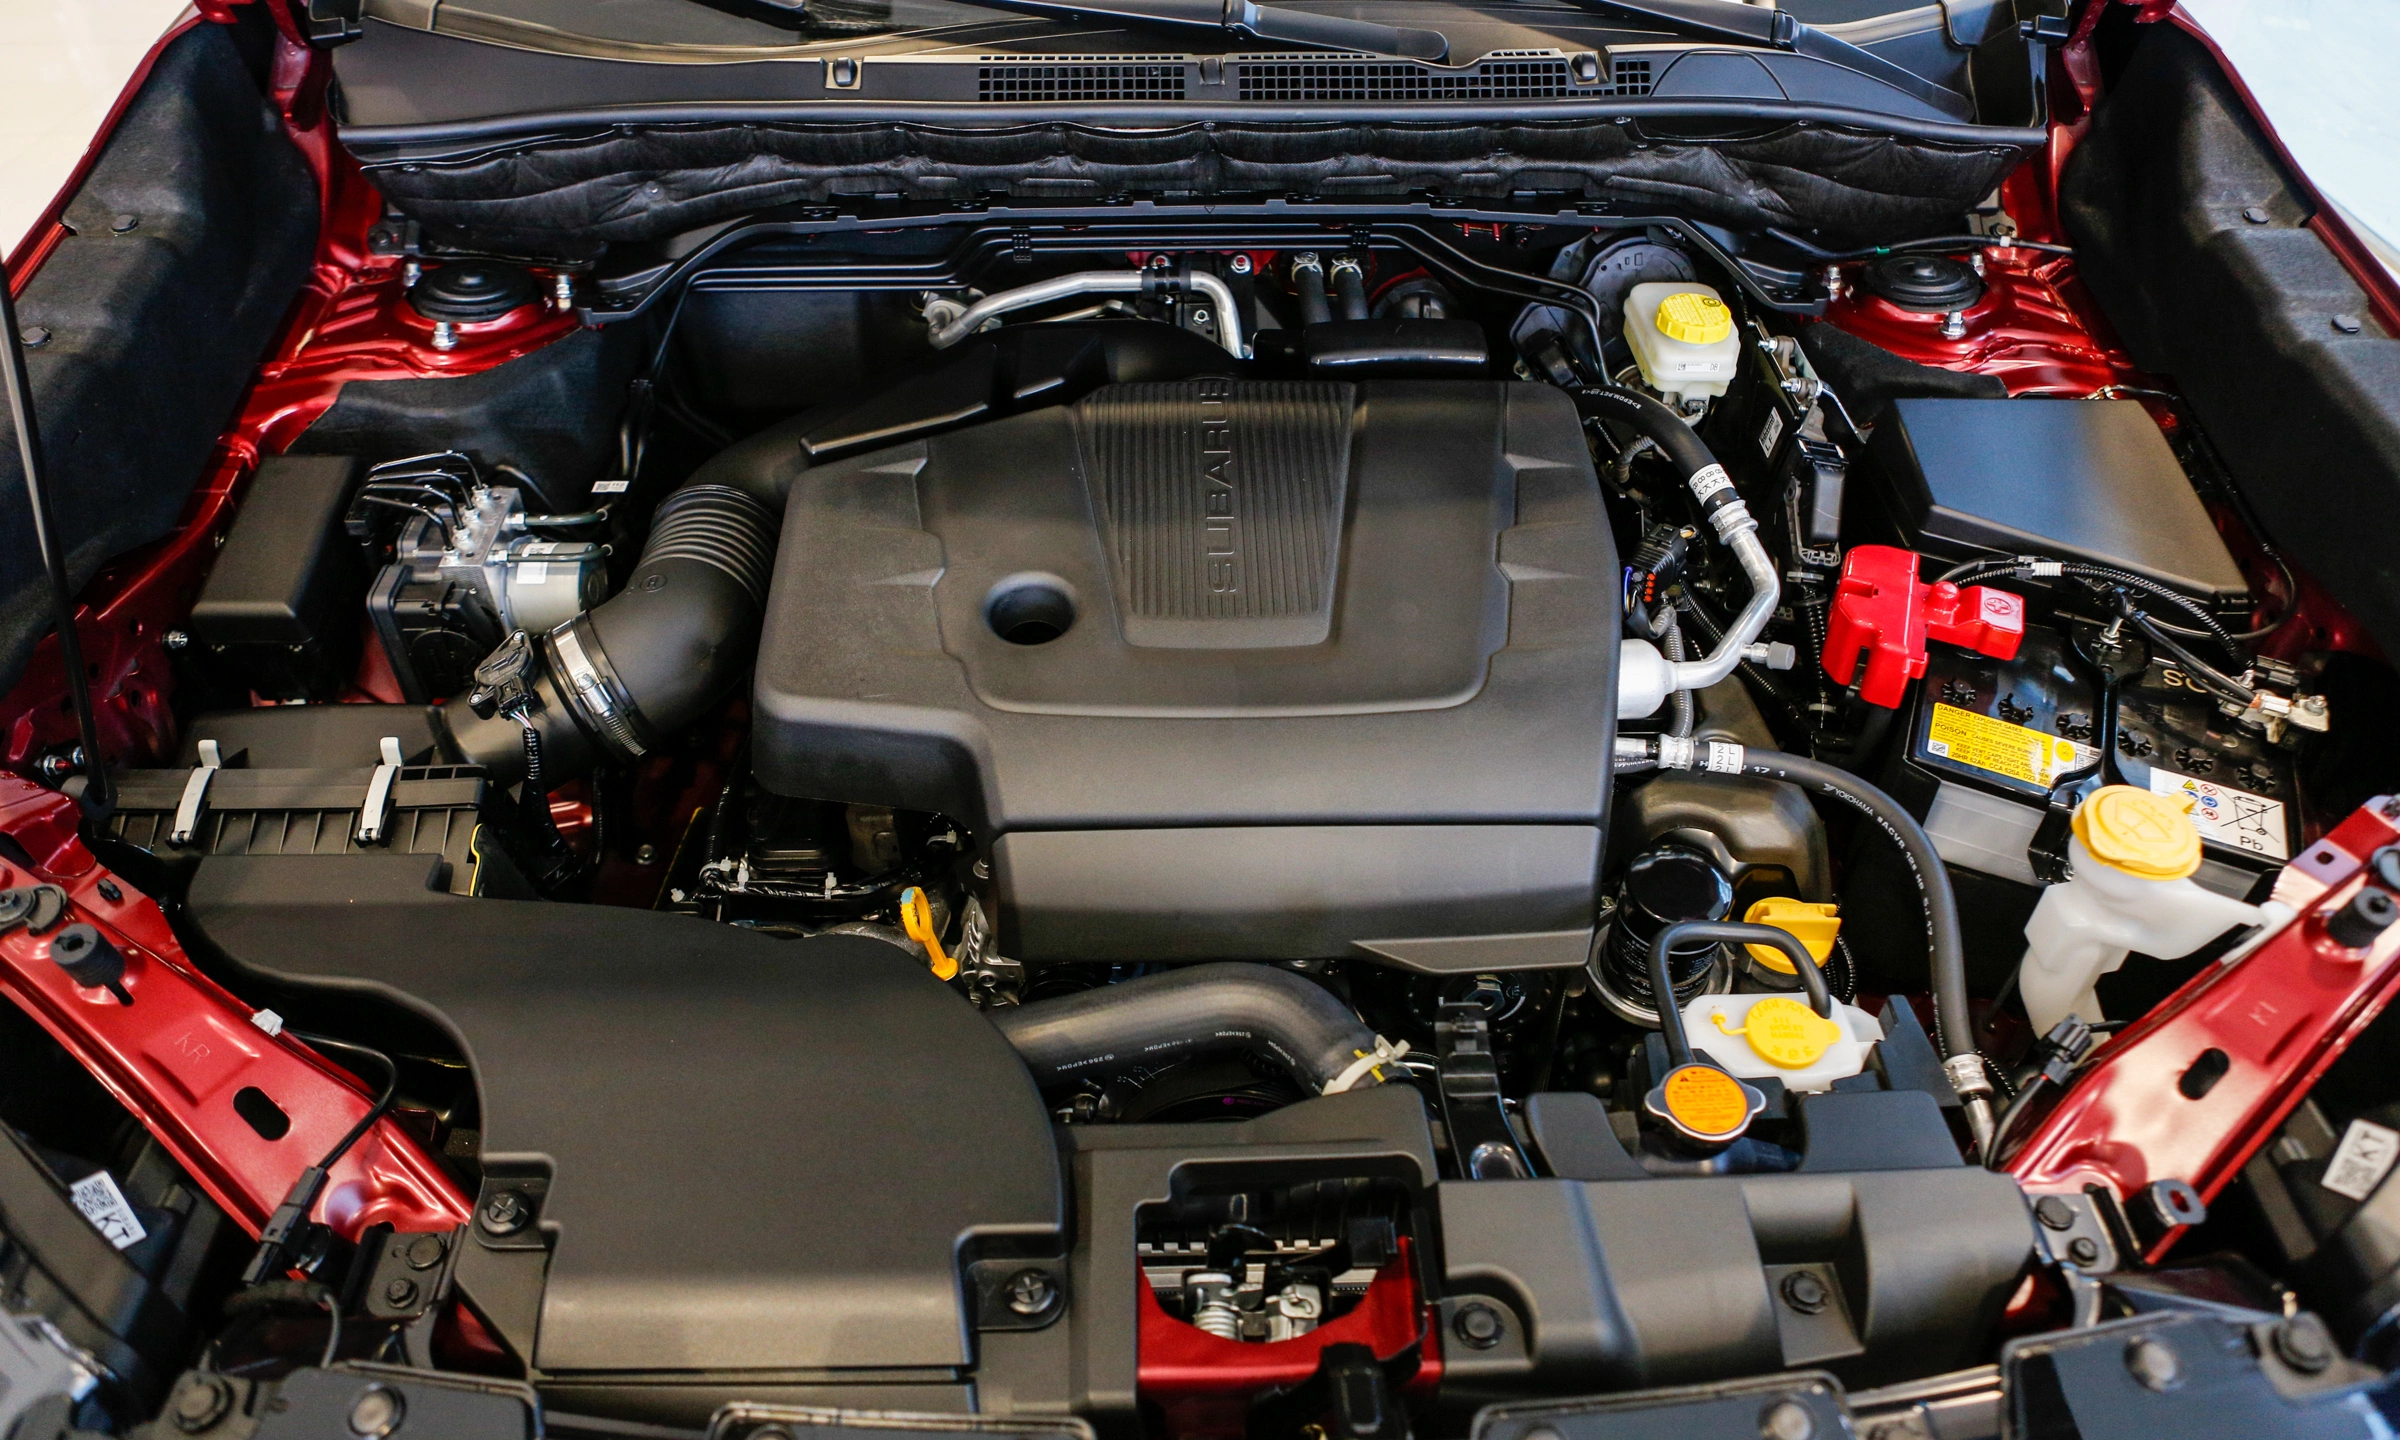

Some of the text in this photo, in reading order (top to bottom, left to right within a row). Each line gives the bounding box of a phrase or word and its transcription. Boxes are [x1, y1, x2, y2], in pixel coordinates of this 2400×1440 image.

[1202, 400, 1238, 594] SUBARU
[1937, 704, 1971, 718] DANGER
[2003, 724, 2022, 733] GASES
[1934, 722, 1967, 736] POISON
[1971, 733, 1993, 743] CAUSES
[1994, 740, 2016, 750] SEVERE
[1956, 742, 1969, 750] KEEP
[1987, 751, 2002, 759] CAPS
[1988, 762, 2003, 771] CCA
[1834, 789, 1874, 816] YOKOHAMA
[2240, 836, 2263, 851] Pb
[174, 1032, 210, 1063] KR
[95, 1211, 130, 1241] KT
